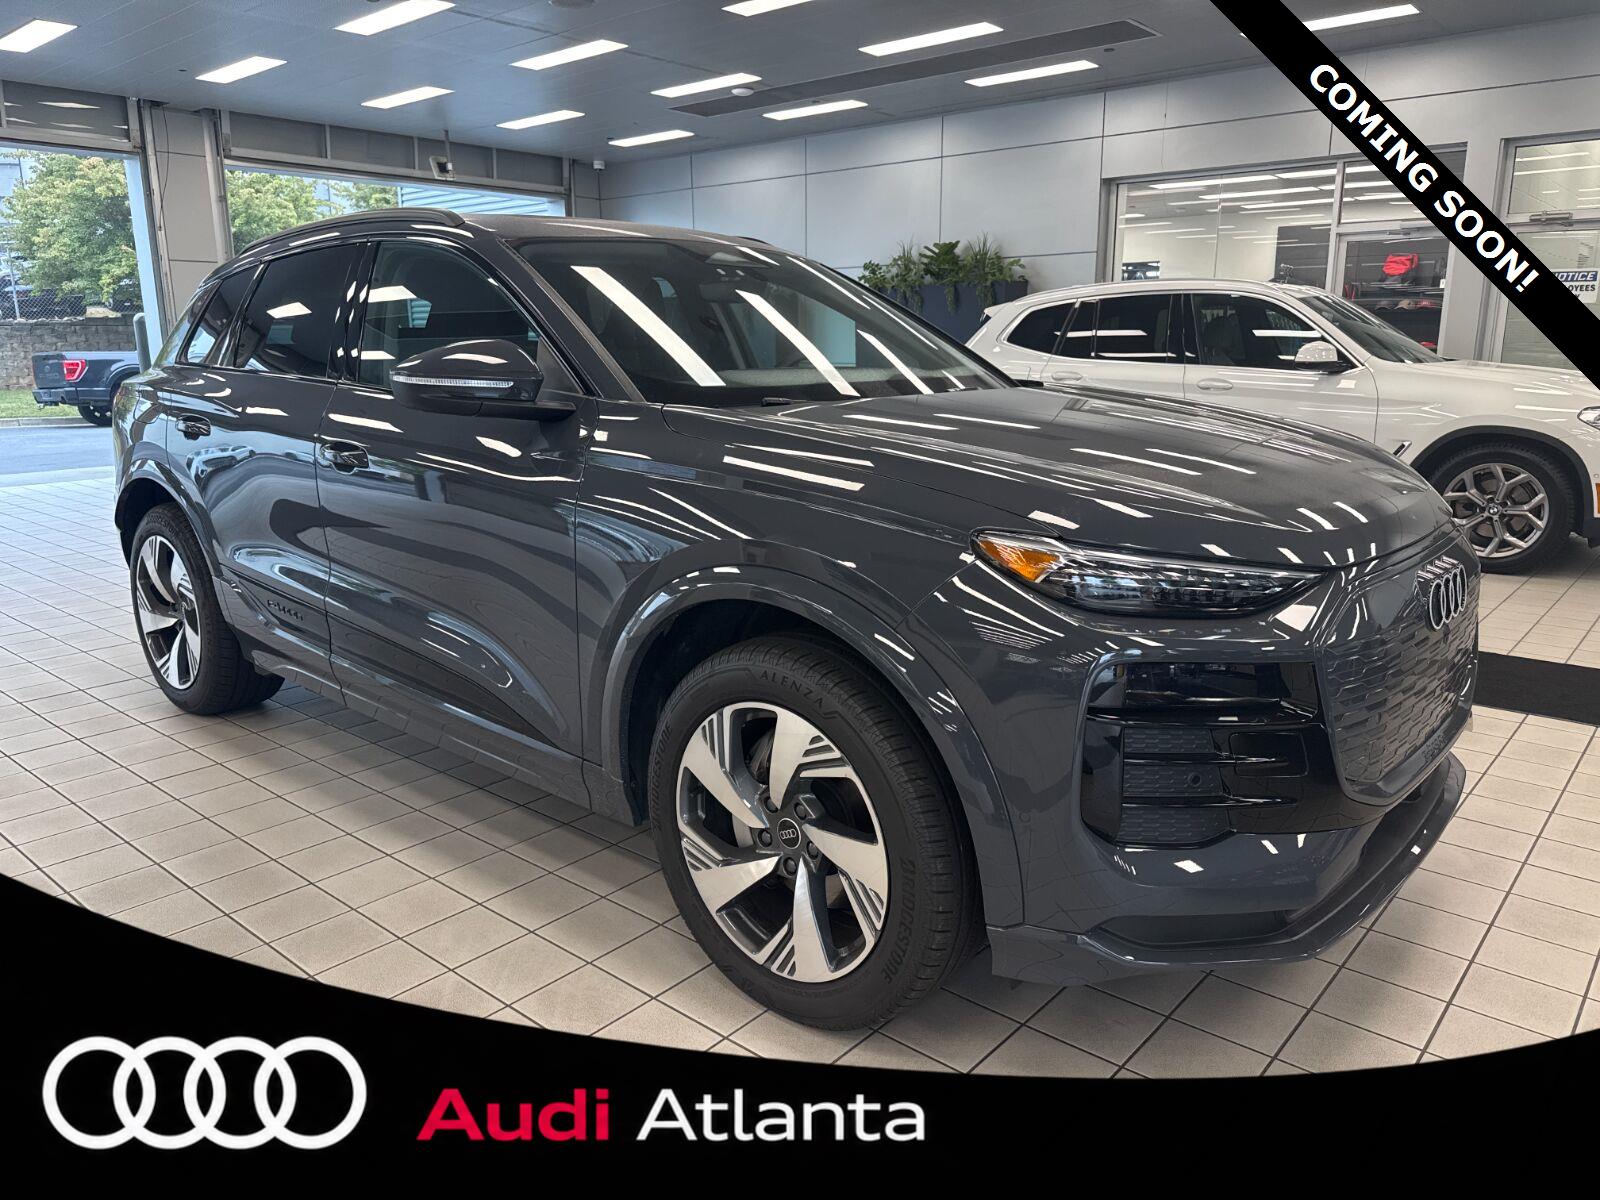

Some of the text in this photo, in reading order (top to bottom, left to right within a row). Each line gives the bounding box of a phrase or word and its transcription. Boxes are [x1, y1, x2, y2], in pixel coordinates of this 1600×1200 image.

[1568, 284, 1596, 292] OYEES
[760, 669, 823, 709] ALENZA
[881, 855, 917, 985] BRIDGESTONE
